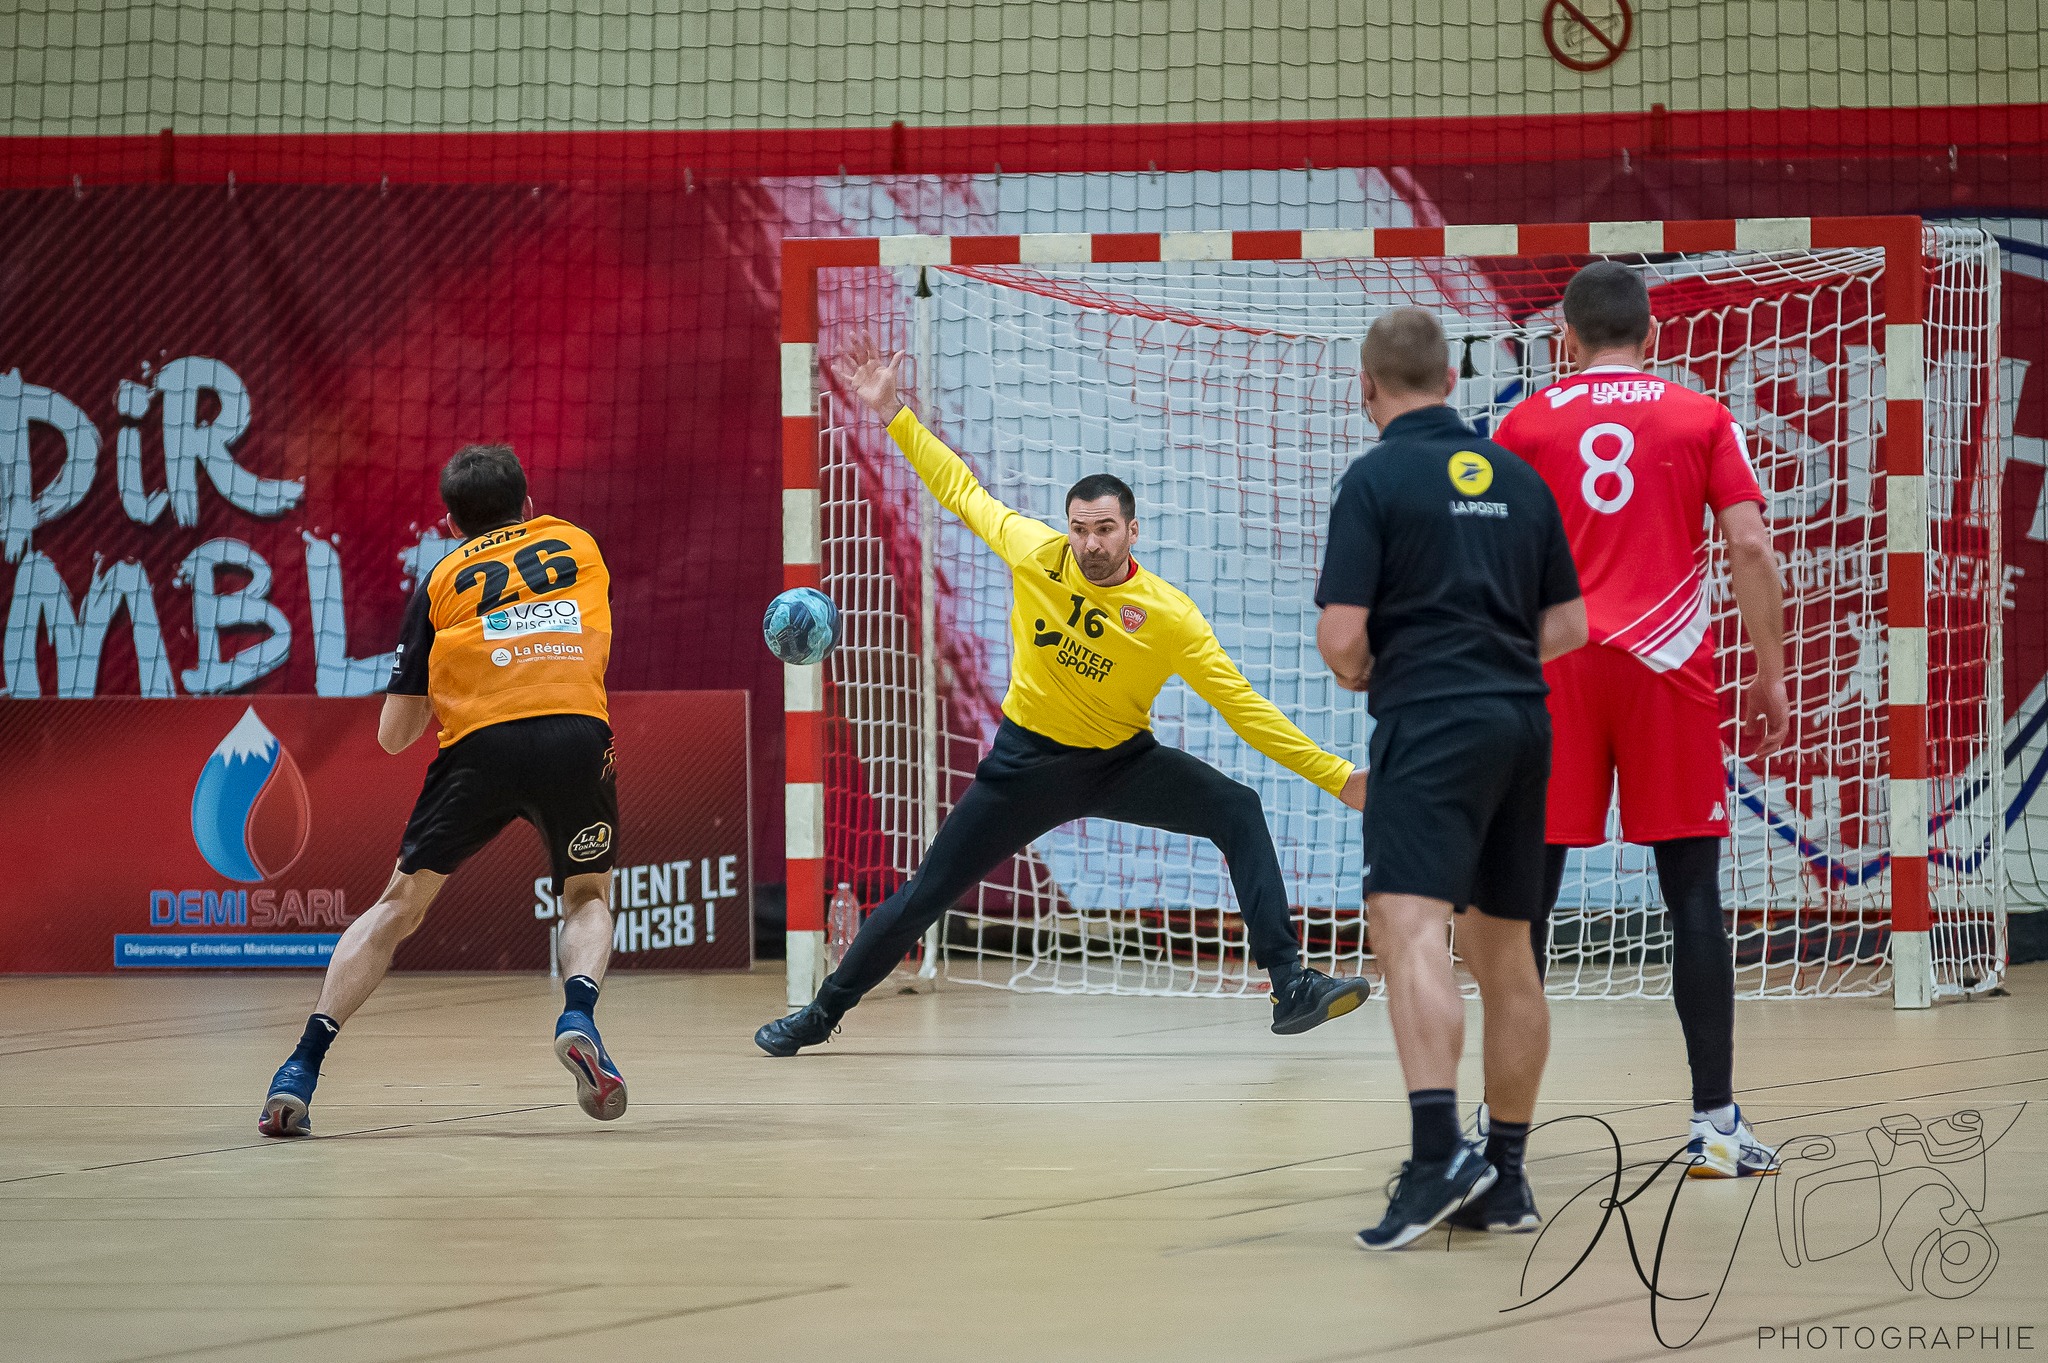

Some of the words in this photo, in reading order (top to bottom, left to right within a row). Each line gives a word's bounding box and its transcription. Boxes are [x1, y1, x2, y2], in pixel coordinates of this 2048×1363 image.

[1592, 389, 1661, 405] SPORT
[1593, 381, 1665, 393] INTER
[1579, 423, 1635, 515] 8
[1449, 500, 1468, 516] LA
[1468, 501, 1509, 518] POSTE
[454, 539, 579, 617] 26
[513, 601, 575, 619] VGO
[1067, 594, 1109, 638] 16
[514, 645, 531, 656] La
[533, 642, 583, 655] Région
[1062, 637, 1115, 672] INTER
[1056, 650, 1109, 683] SPORT
[534, 859, 692, 919] STIENT
[701, 854, 737, 899] LE
[191, 944, 241, 955] Entretien
[244, 944, 315, 955] Maintenance
